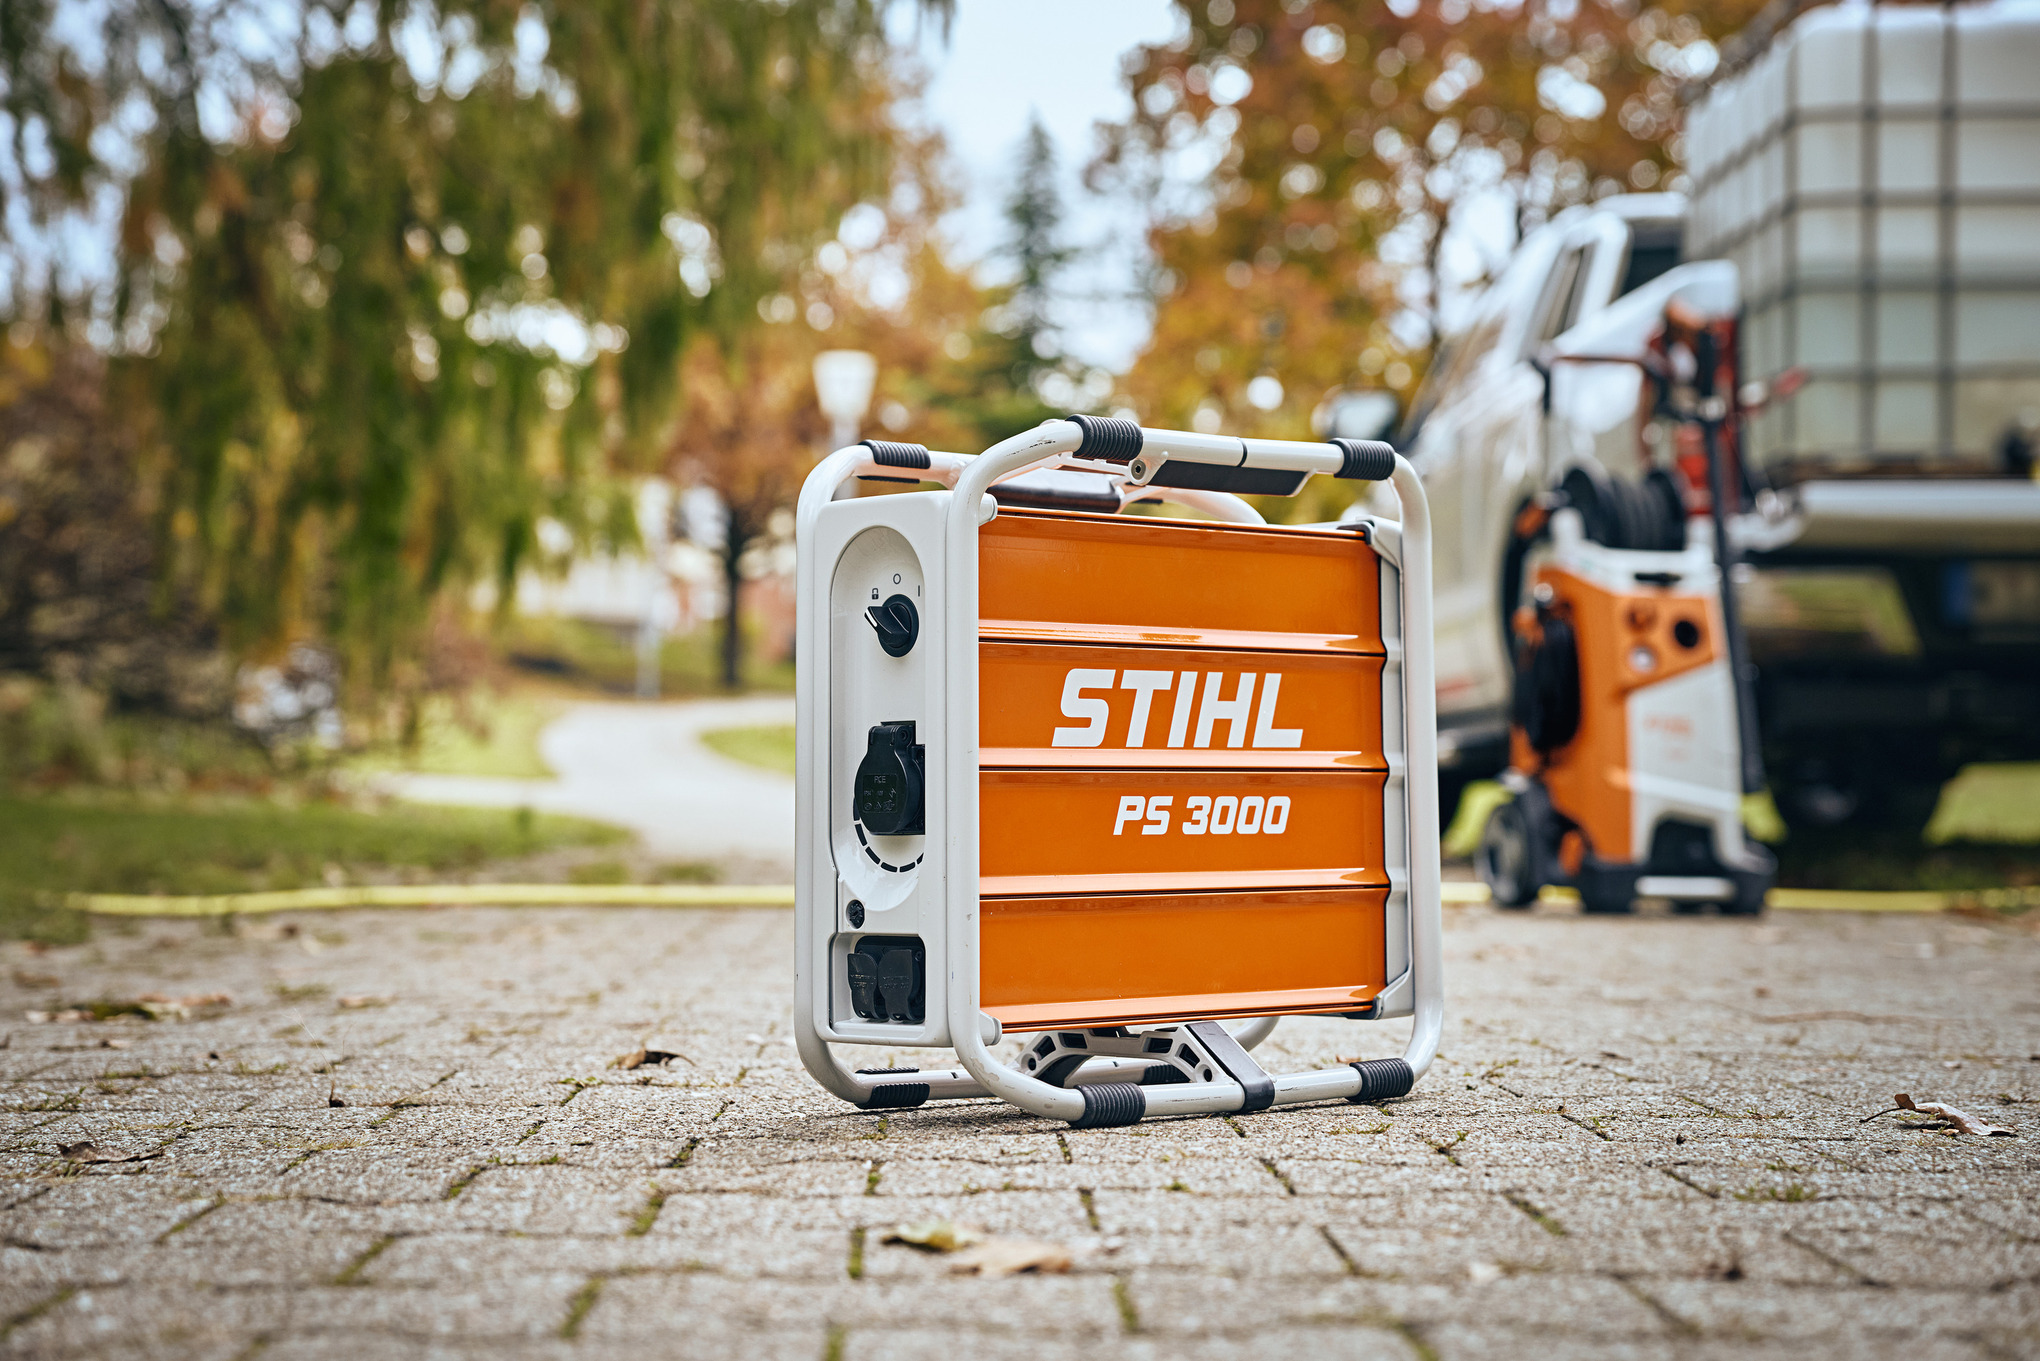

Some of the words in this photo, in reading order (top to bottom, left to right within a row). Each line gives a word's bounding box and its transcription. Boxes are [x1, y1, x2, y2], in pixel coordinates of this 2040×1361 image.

[1051, 668, 1304, 749] STIHL
[1112, 795, 1174, 836] PS
[1182, 795, 1291, 835] 3000
